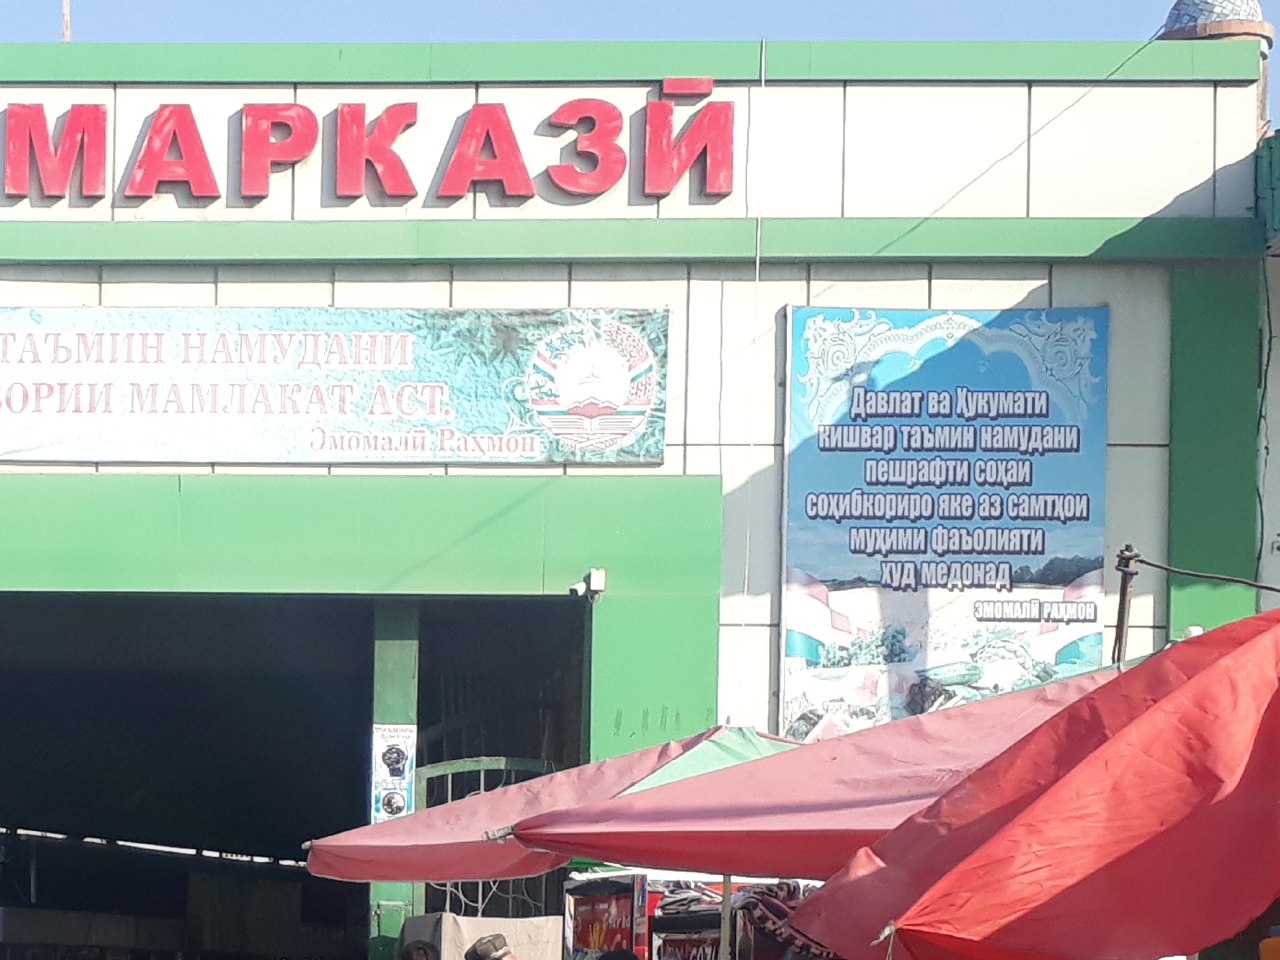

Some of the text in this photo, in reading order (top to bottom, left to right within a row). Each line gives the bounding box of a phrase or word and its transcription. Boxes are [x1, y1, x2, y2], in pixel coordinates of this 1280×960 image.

[181, 331, 410, 370] НАМУДАНИ
[128, 382, 354, 415] МАМЛАКАТ
[367, 383, 452, 416] АСТ.
[851, 387, 1049, 420] Давлат ва Ҳукумати
[437, 427, 537, 456] Раҳмон
[818, 425, 1080, 454] кишвар таъмин намудани
[865, 457, 1033, 488] пешрафти соҳаи
[805, 489, 1090, 524] соҳибкориро яке аз самтҳои
[849, 525, 1045, 556] муҳими фаъолияти
[880, 561, 1012, 591] худ медонад
